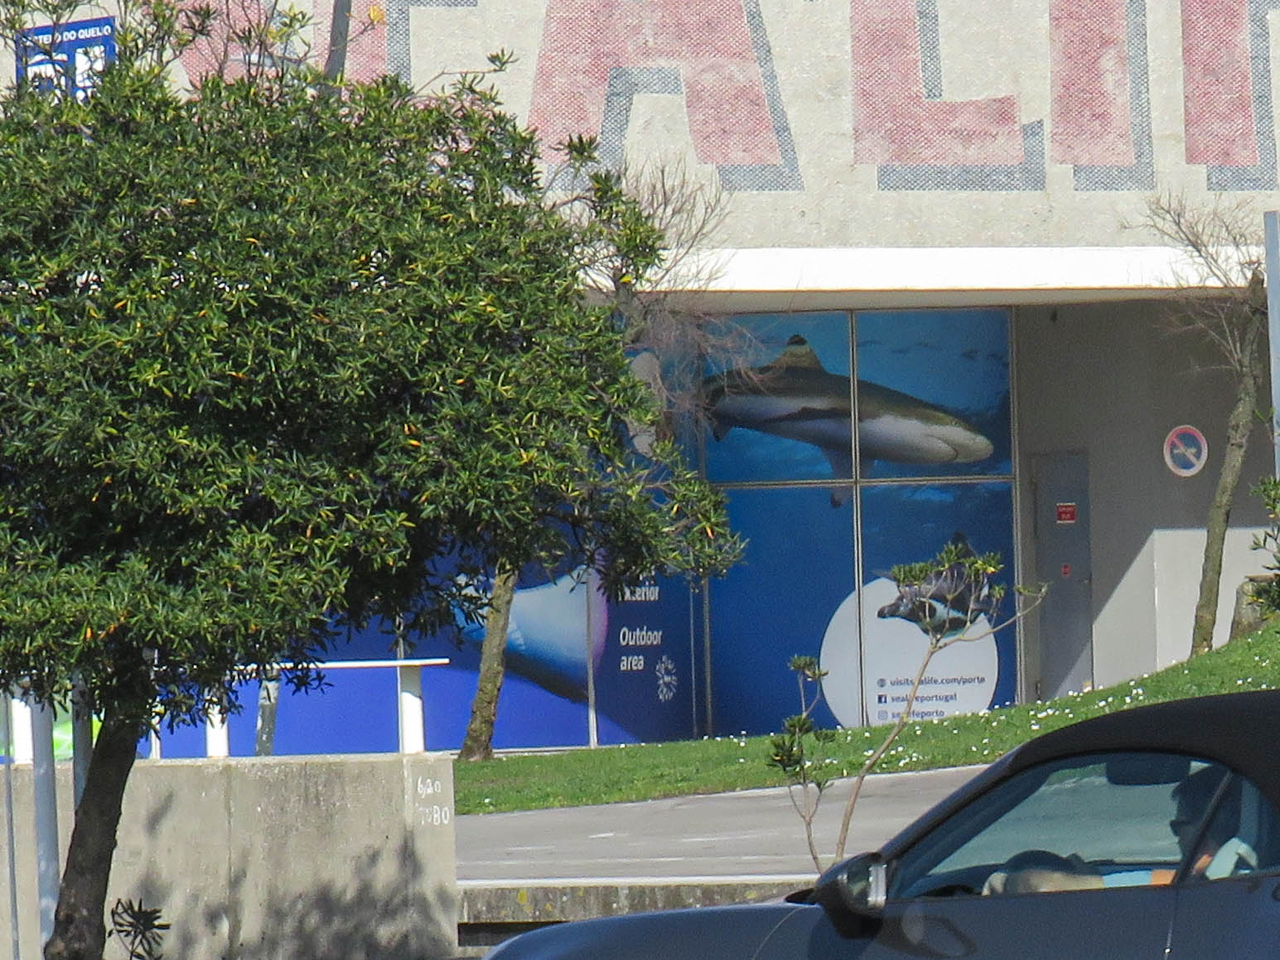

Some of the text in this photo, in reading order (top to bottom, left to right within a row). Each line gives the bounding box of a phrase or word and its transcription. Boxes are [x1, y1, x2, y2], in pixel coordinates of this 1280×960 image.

[63, 30, 77, 41] DO
[78, 25, 111, 38] QUEIO
[620, 626, 662, 645] Outdoor
[620, 655, 645, 670] area
[890, 676, 986, 687] visitsalife.com/porto
[891, 692, 957, 703] sealeportugal
[891, 709, 945, 719] sefeporto
